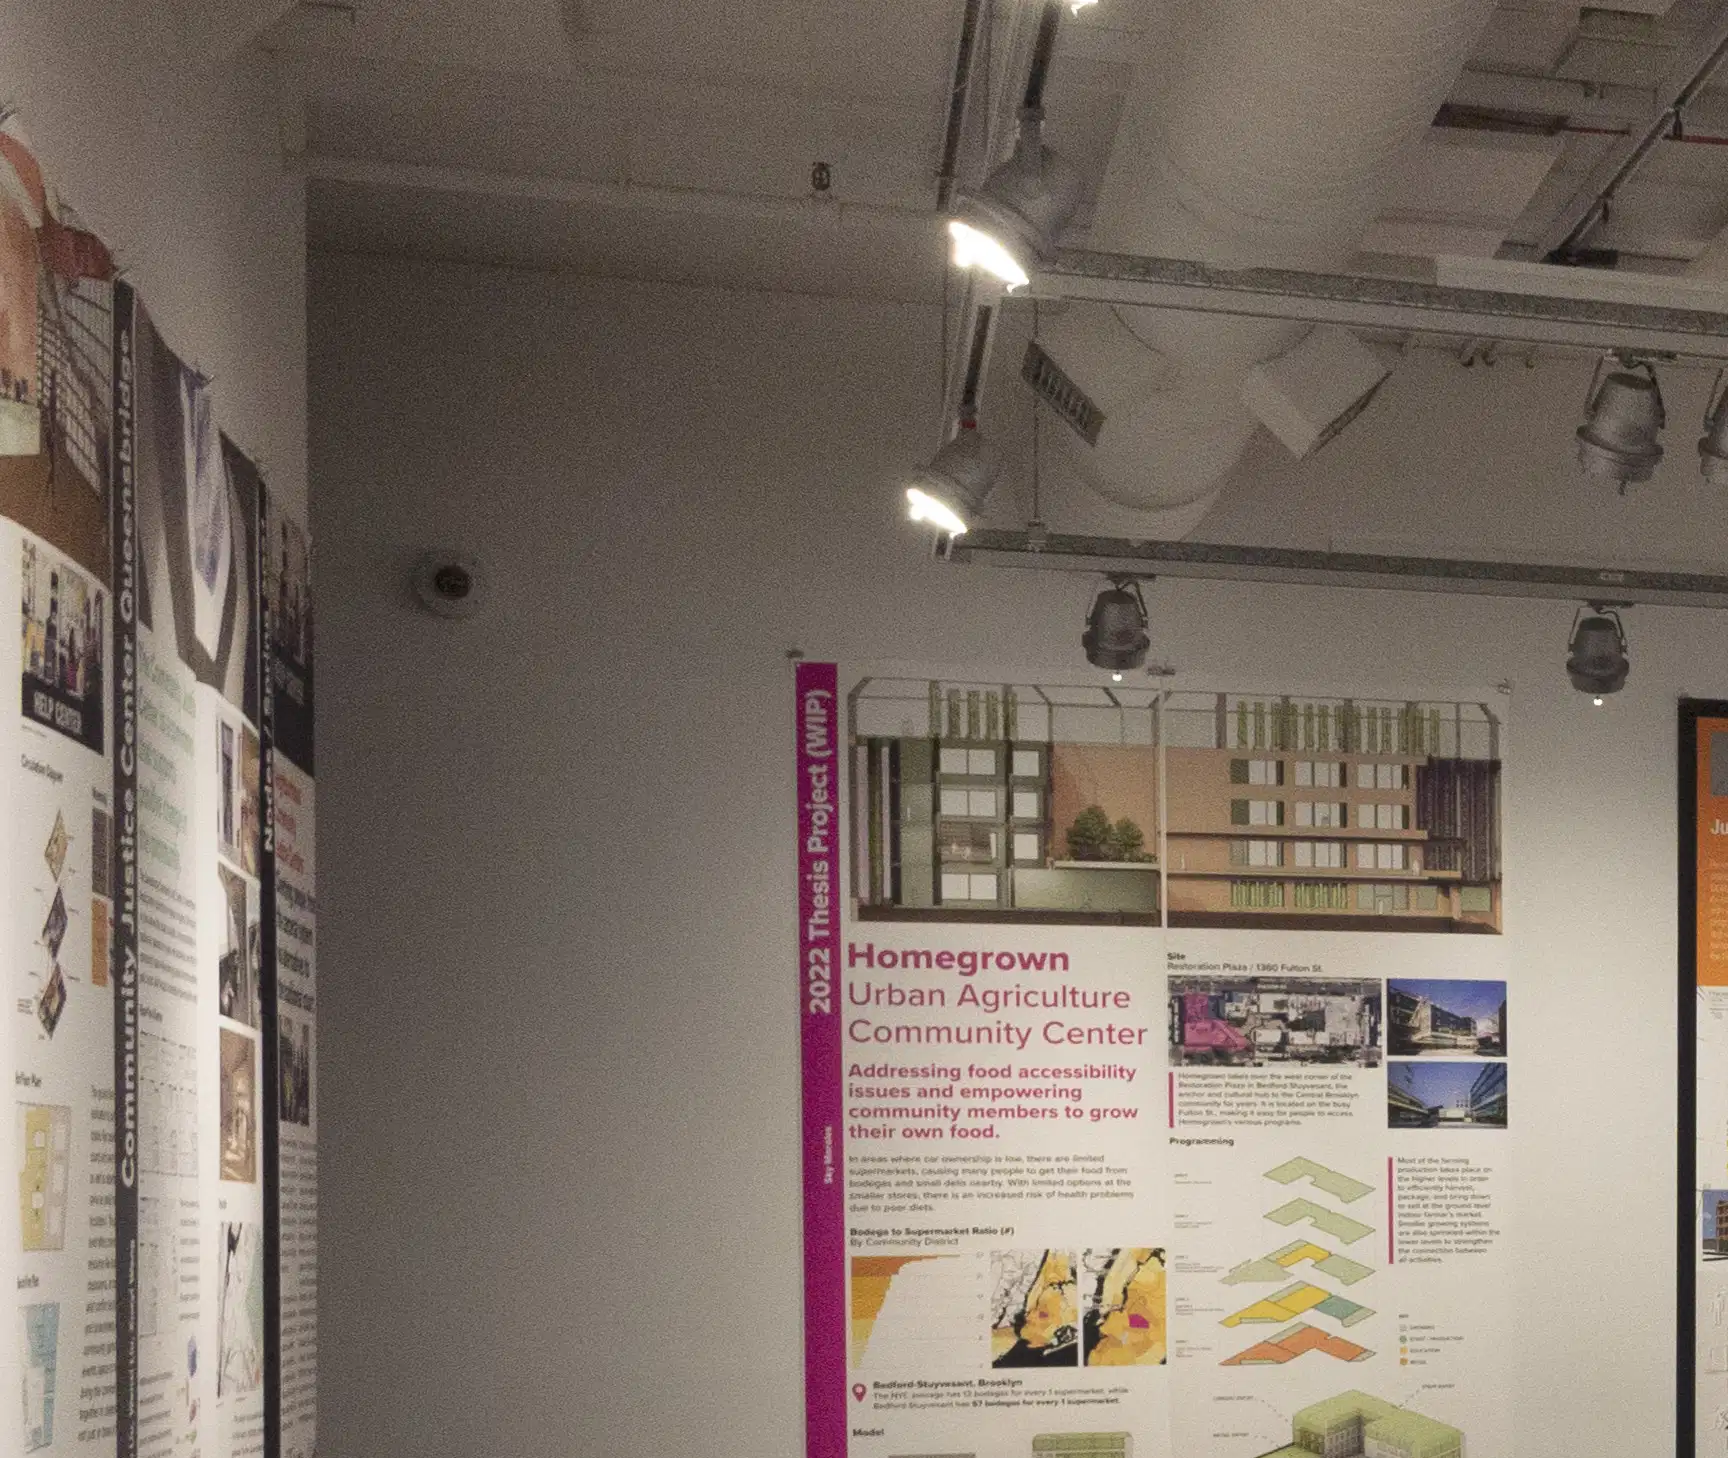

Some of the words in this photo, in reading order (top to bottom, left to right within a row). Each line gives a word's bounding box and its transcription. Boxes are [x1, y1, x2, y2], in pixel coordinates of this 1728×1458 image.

[118, 326, 134, 624] Queensbridge
[120, 635, 135, 777] Center
[805, 688, 831, 758] (WIP)
[806, 765, 835, 854] Project
[121, 788, 136, 934] Justice
[808, 861, 831, 940] Thesis
[848, 942, 1069, 977] Homegrown
[1167, 952, 1186, 961] Site
[1167, 962, 1220, 971] Restoration
[1222, 963, 1248, 972] Plaza
[1281, 964, 1310, 972] Fulton
[809, 948, 831, 1015] 2022
[848, 982, 945, 1007] Urban
[957, 983, 1131, 1012] Agriculture
[848, 1019, 1032, 1049] Community
[1042, 1021, 1148, 1046] Center
[121, 944, 137, 1188] Community
[848, 1063, 961, 1081] Addressing
[968, 1064, 1012, 1079] food
[1019, 1064, 1136, 1081] accessibility
[848, 1084, 910, 1099] issues
[918, 1086, 953, 1099] and
[961, 1086, 1082, 1101] empowering
[848, 1104, 959, 1121] community
[968, 1104, 1058, 1118] members
[1065, 1106, 1083, 1118] to
[1090, 1107, 1138, 1121] grow
[849, 1124, 896, 1138] their
[902, 1126, 943, 1139] own
[951, 1125, 1000, 1139] food.
[1169, 1138, 1234, 1148] Programming
